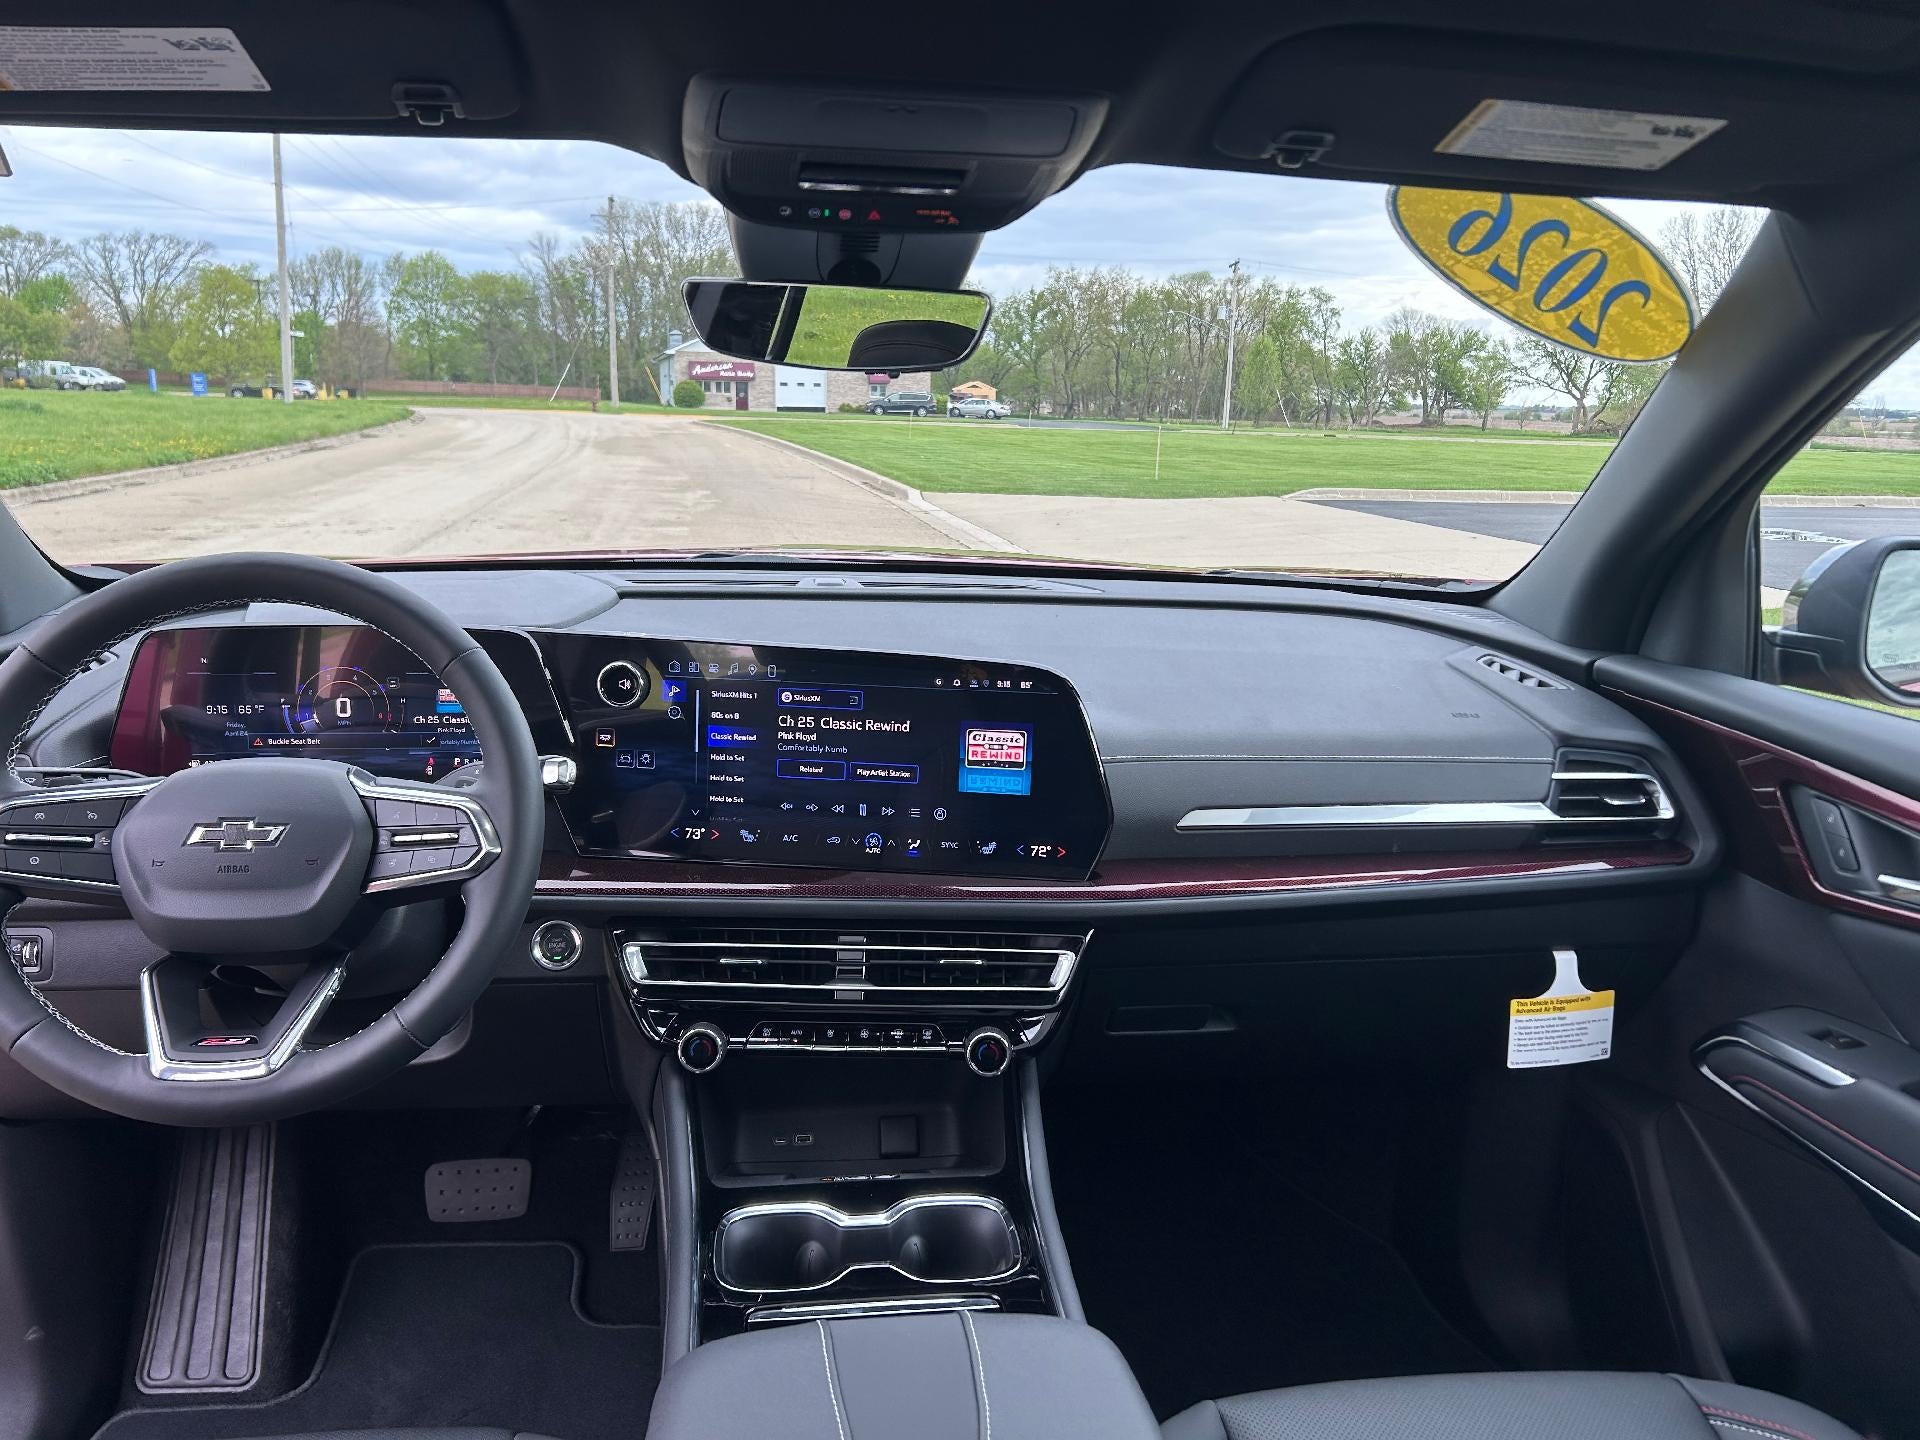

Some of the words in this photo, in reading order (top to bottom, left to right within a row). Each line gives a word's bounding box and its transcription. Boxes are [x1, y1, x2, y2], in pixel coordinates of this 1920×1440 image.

[692, 361, 734, 375] Anderson
[711, 690, 740, 698] SiriusXM
[740, 691, 753, 699] Hits
[793, 694, 821, 702] SiriusXM
[206, 705, 228, 714] 9:15
[238, 705, 252, 714] 65
[336, 698, 351, 717] 0
[414, 715, 426, 724] Ch
[427, 715, 440, 724] 25
[778, 714, 795, 727] Ch
[797, 716, 815, 728] 25
[820, 717, 863, 731] Classic
[865, 720, 911, 732] Rewind
[268, 737, 290, 745] Buckle
[307, 737, 321, 745] Belt
[710, 732, 733, 740] Classic
[733, 733, 757, 741] Rewind
[777, 731, 795, 740] Pink
[795, 731, 817, 742] Floyd
[972, 733, 1022, 744] Classic
[777, 742, 824, 753] Comfortably
[825, 744, 848, 754] Numb
[710, 753, 726, 761] Hold
[734, 754, 745, 762] Set
[971, 749, 1021, 760] REWIND
[799, 765, 824, 773] Related
[709, 774, 726, 782] Hold
[782, 834, 799, 842] A/C
[940, 841, 959, 849] SYNC
[216, 864, 251, 874] AIRBAG
[1552, 1004, 1566, 1012] Bags
